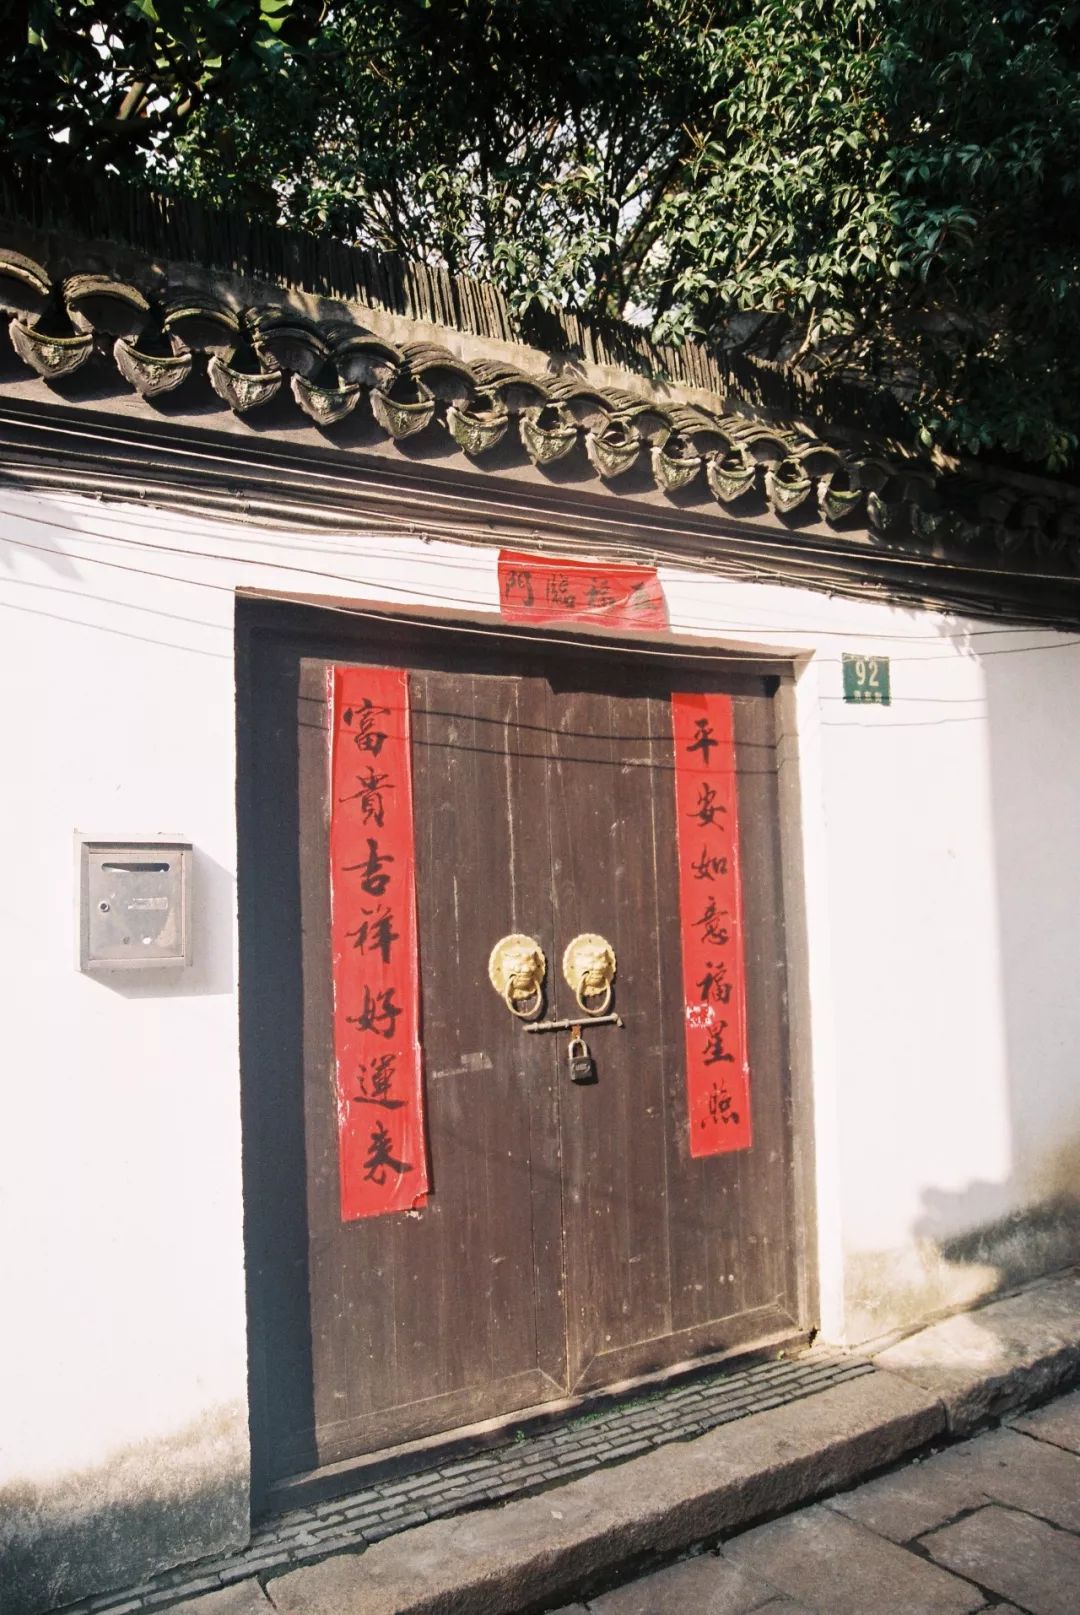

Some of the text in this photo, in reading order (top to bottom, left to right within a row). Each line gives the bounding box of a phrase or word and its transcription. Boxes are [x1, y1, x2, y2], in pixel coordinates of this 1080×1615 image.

[855, 661, 880, 687] 92
[686, 718, 740, 1130] 平安如意福星照
